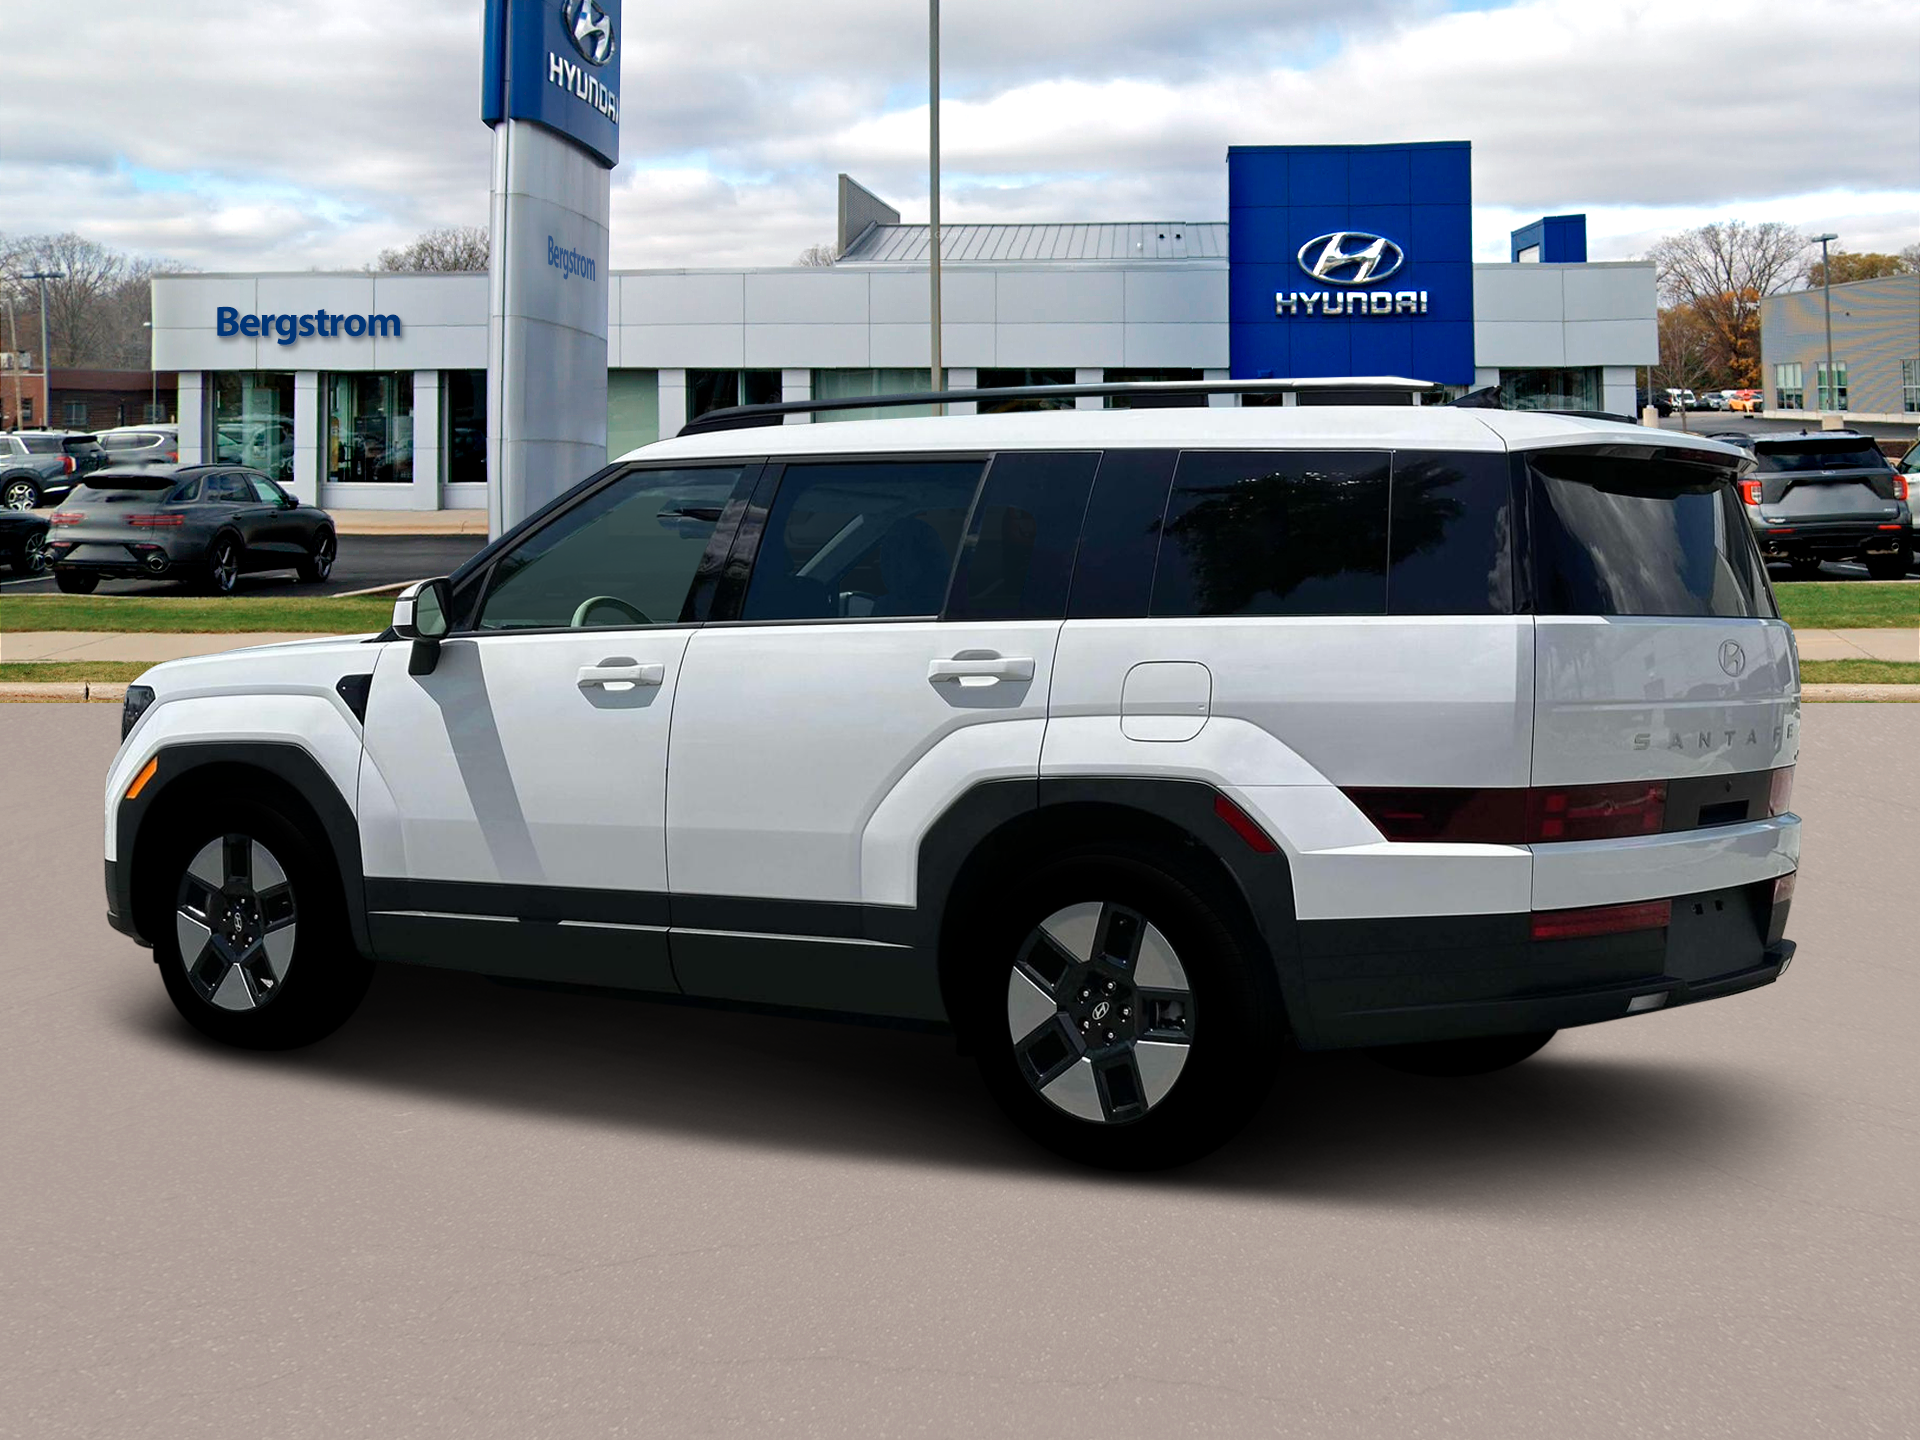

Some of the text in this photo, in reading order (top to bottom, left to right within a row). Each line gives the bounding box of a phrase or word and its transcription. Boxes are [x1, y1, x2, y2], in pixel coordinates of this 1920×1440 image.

[549, 51, 619, 124] HYUNDAI
[548, 235, 595, 282] Bergstrom
[1275, 290, 1428, 315] HYUNDAI
[216, 306, 401, 346] Bergstrom
[1633, 722, 1796, 751] SANTA FE
